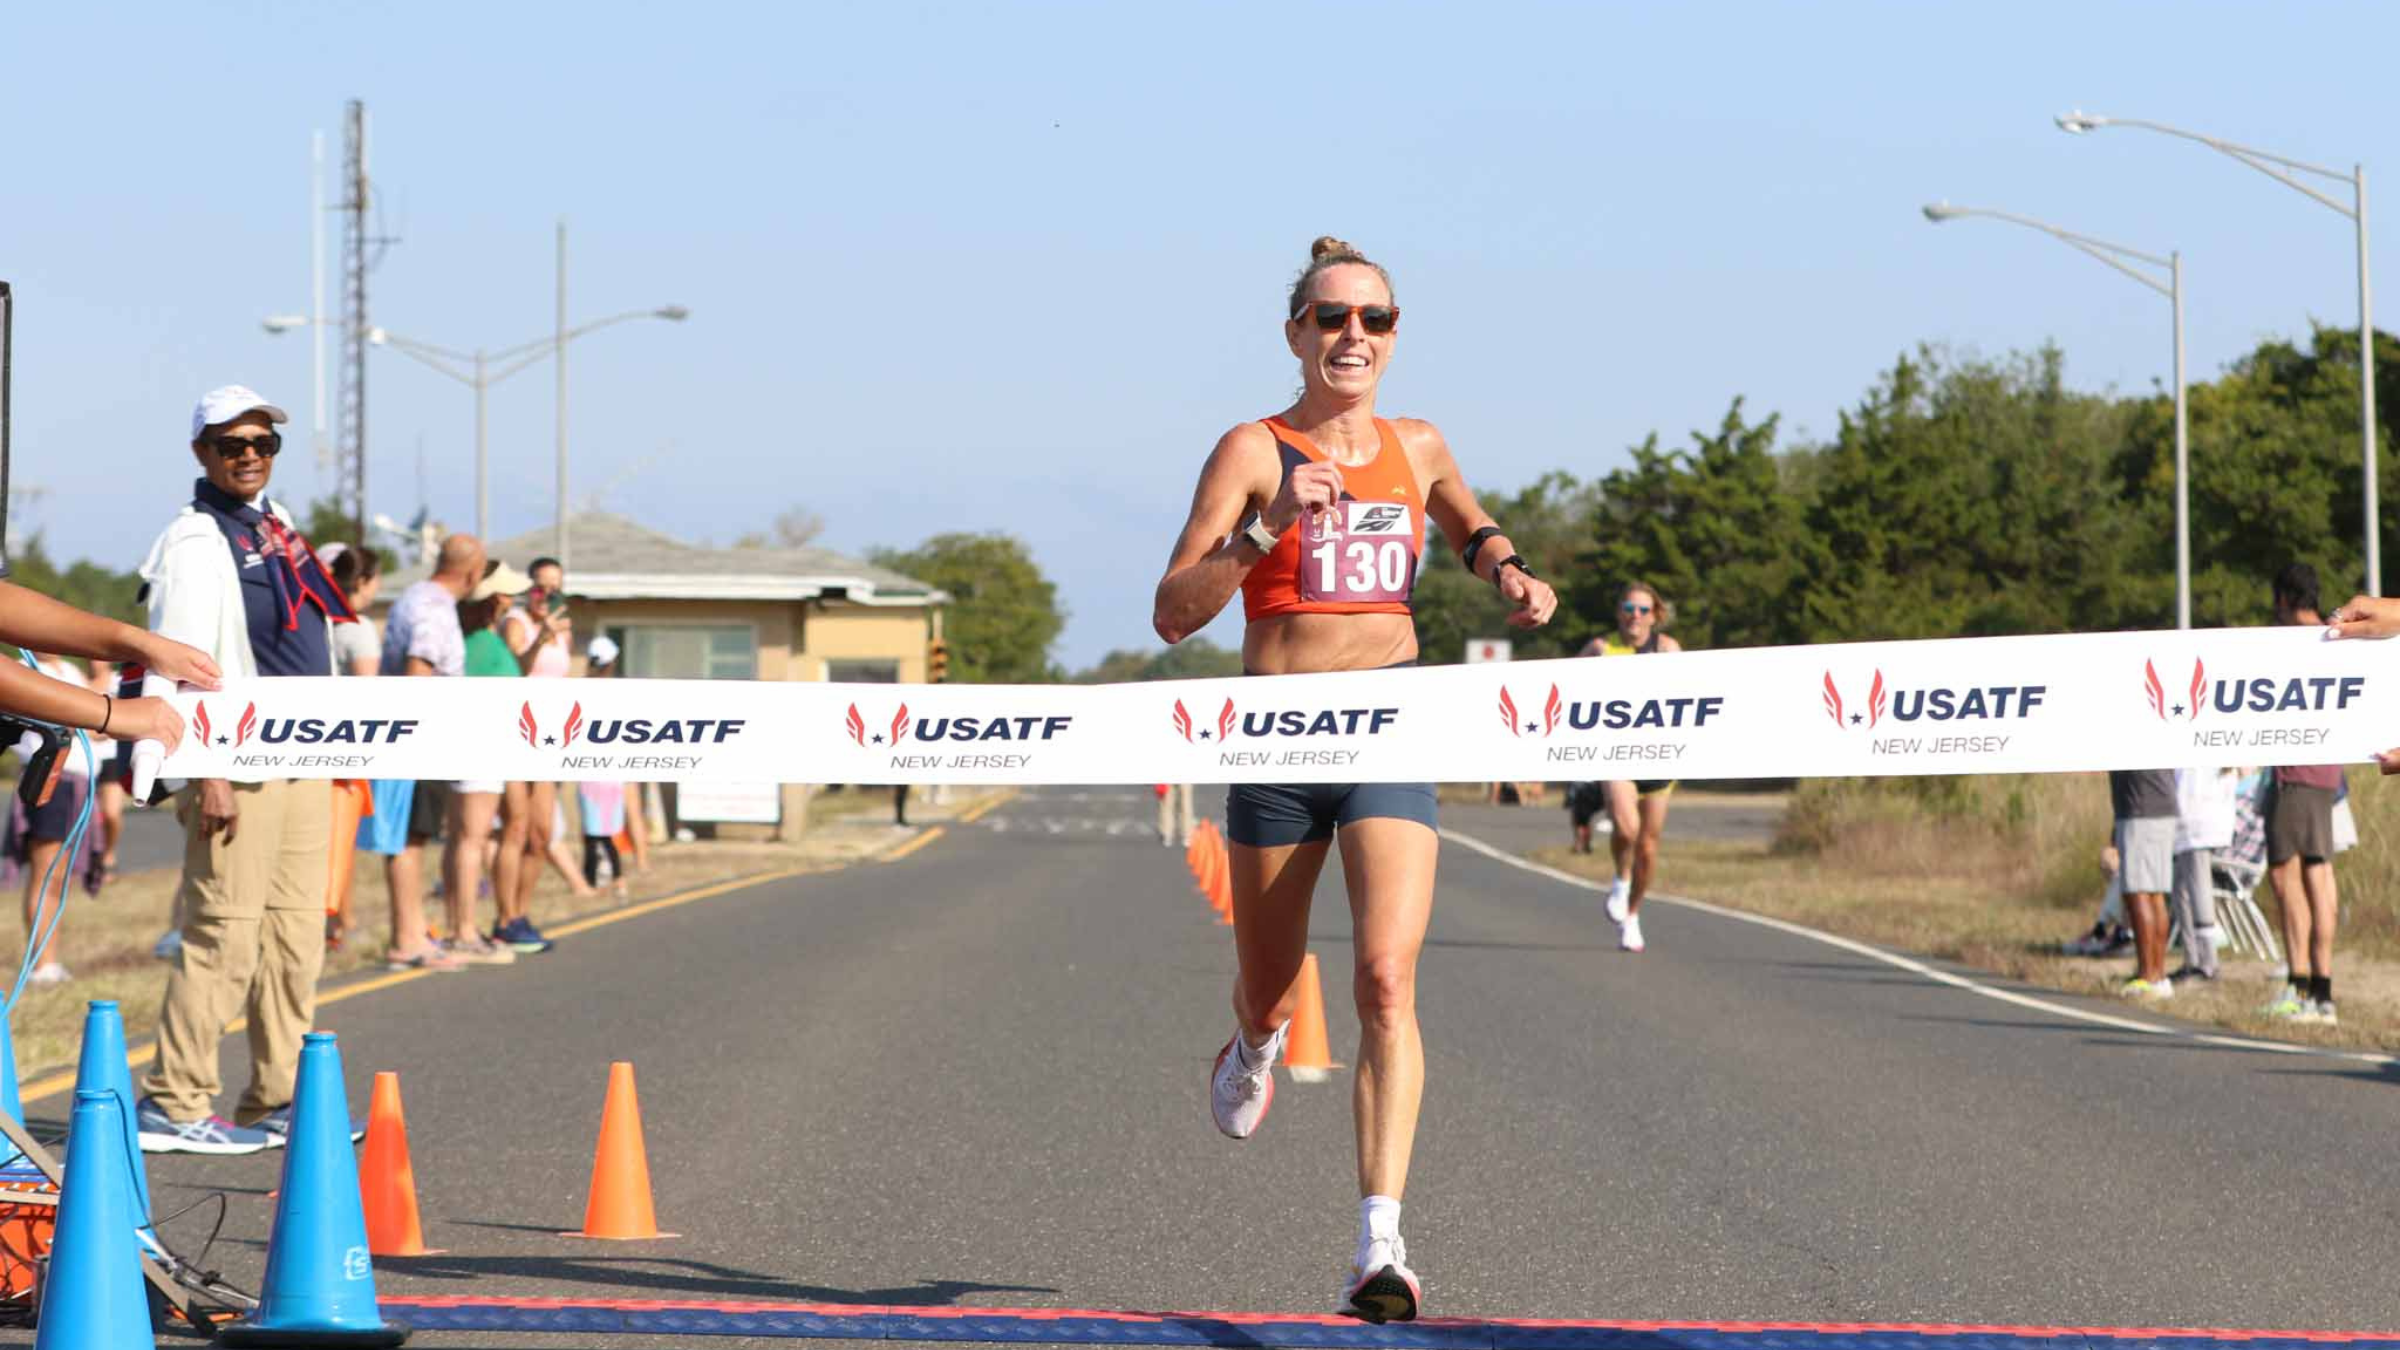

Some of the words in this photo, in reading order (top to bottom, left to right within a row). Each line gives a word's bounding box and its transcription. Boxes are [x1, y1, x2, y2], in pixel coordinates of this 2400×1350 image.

[1312, 541, 1407, 592] 130
[1892, 686, 2047, 722] USATF
[2213, 677, 2366, 714] USATF
[1241, 708, 1400, 738] USATF
[1567, 697, 1725, 731] USATF
[259, 718, 420, 745] USATF
[586, 719, 747, 745] USATF
[914, 717, 1074, 743] USATF
[2193, 730, 2243, 747] NEW
[2248, 728, 2330, 746] JERSEY
[1219, 752, 1271, 766] NEW
[1275, 750, 1360, 765] JERSEY
[1546, 746, 1598, 761] NEW
[1602, 744, 1687, 760] JERSEY
[1872, 738, 1922, 754] NEW
[1927, 737, 2010, 753] JERSEY
[233, 755, 286, 767] NEW
[289, 755, 375, 767] JERSEY
[561, 756, 614, 769] NEW
[617, 756, 703, 769] JERSEY
[890, 756, 943, 769] NEW
[945, 755, 1032, 768] JERSEY
